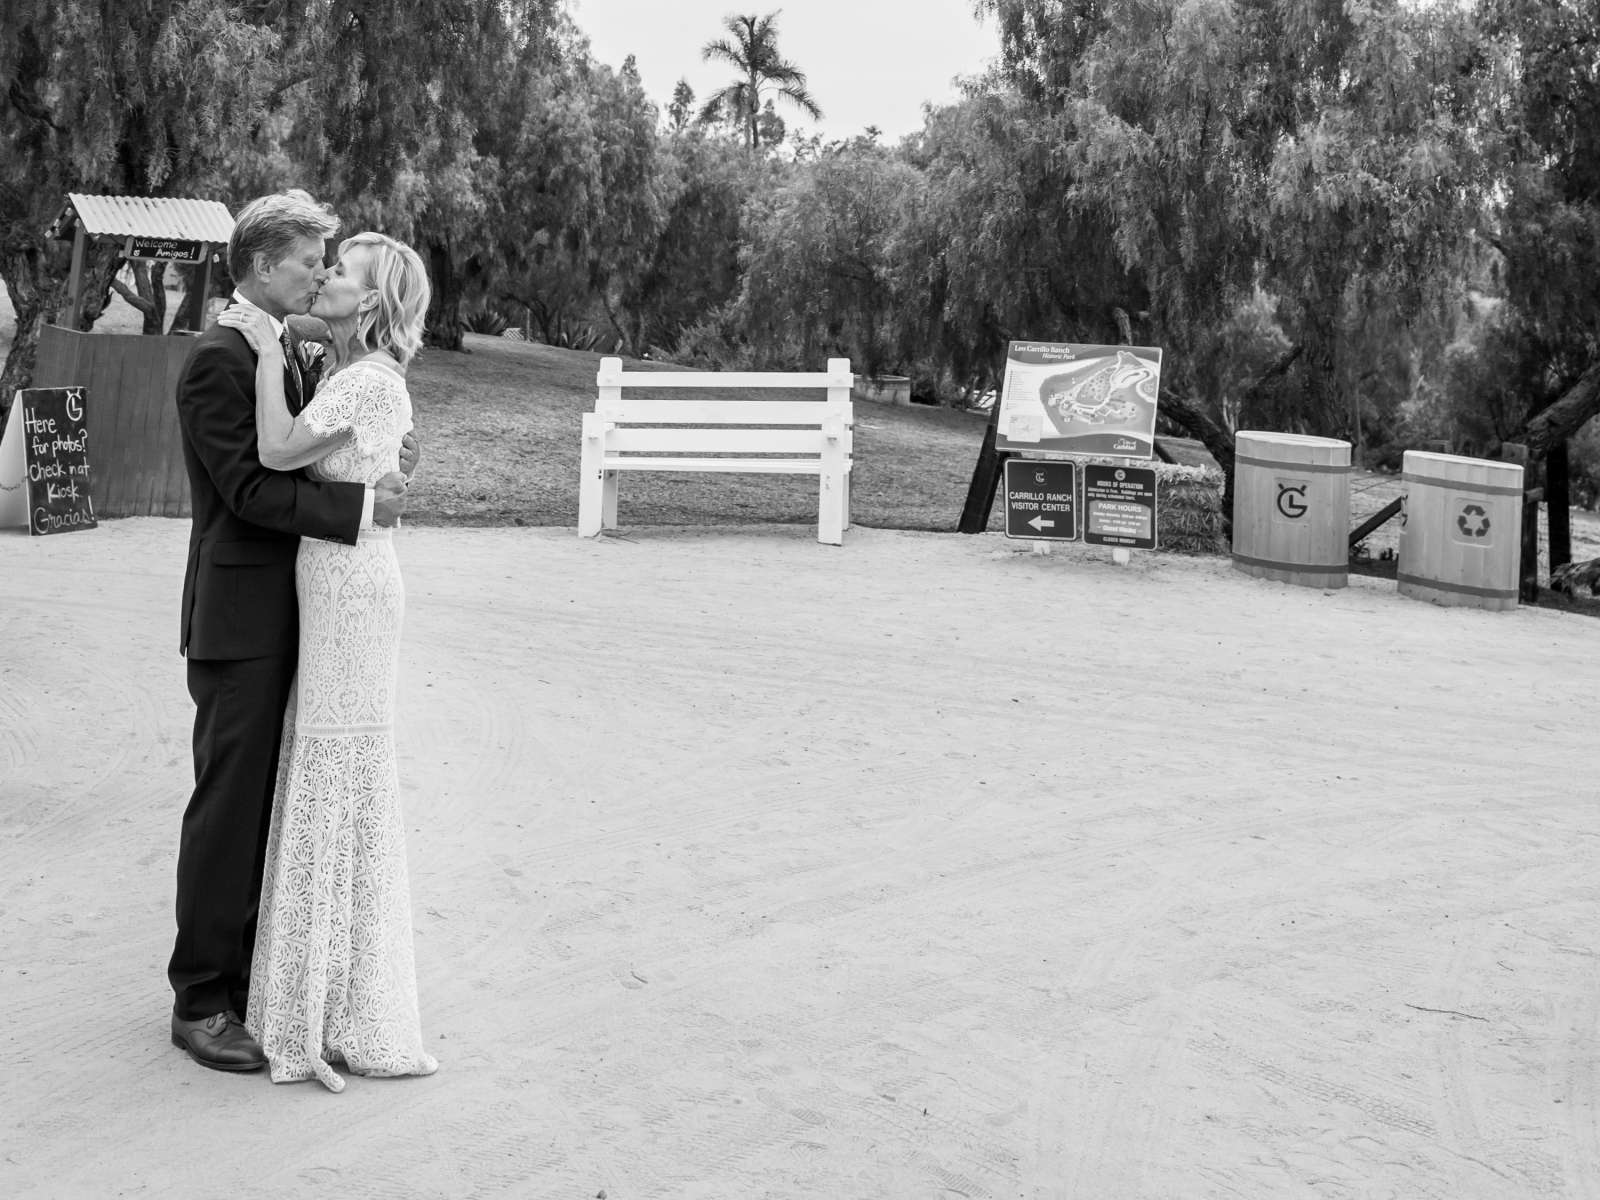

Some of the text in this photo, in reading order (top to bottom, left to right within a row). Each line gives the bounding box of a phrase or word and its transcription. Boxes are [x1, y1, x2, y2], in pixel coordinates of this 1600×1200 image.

[135, 239, 178, 249] Welcome
[25, 407, 57, 434] Here
[31, 429, 88, 458] for photos?
[78, 456, 90, 477] at
[1009, 491, 1072, 502] CARRILLO RANCH
[1011, 501, 1071, 512] VISITOR CENTER
[1098, 502, 1117, 510] PARK
[33, 495, 95, 535] Gracias!
